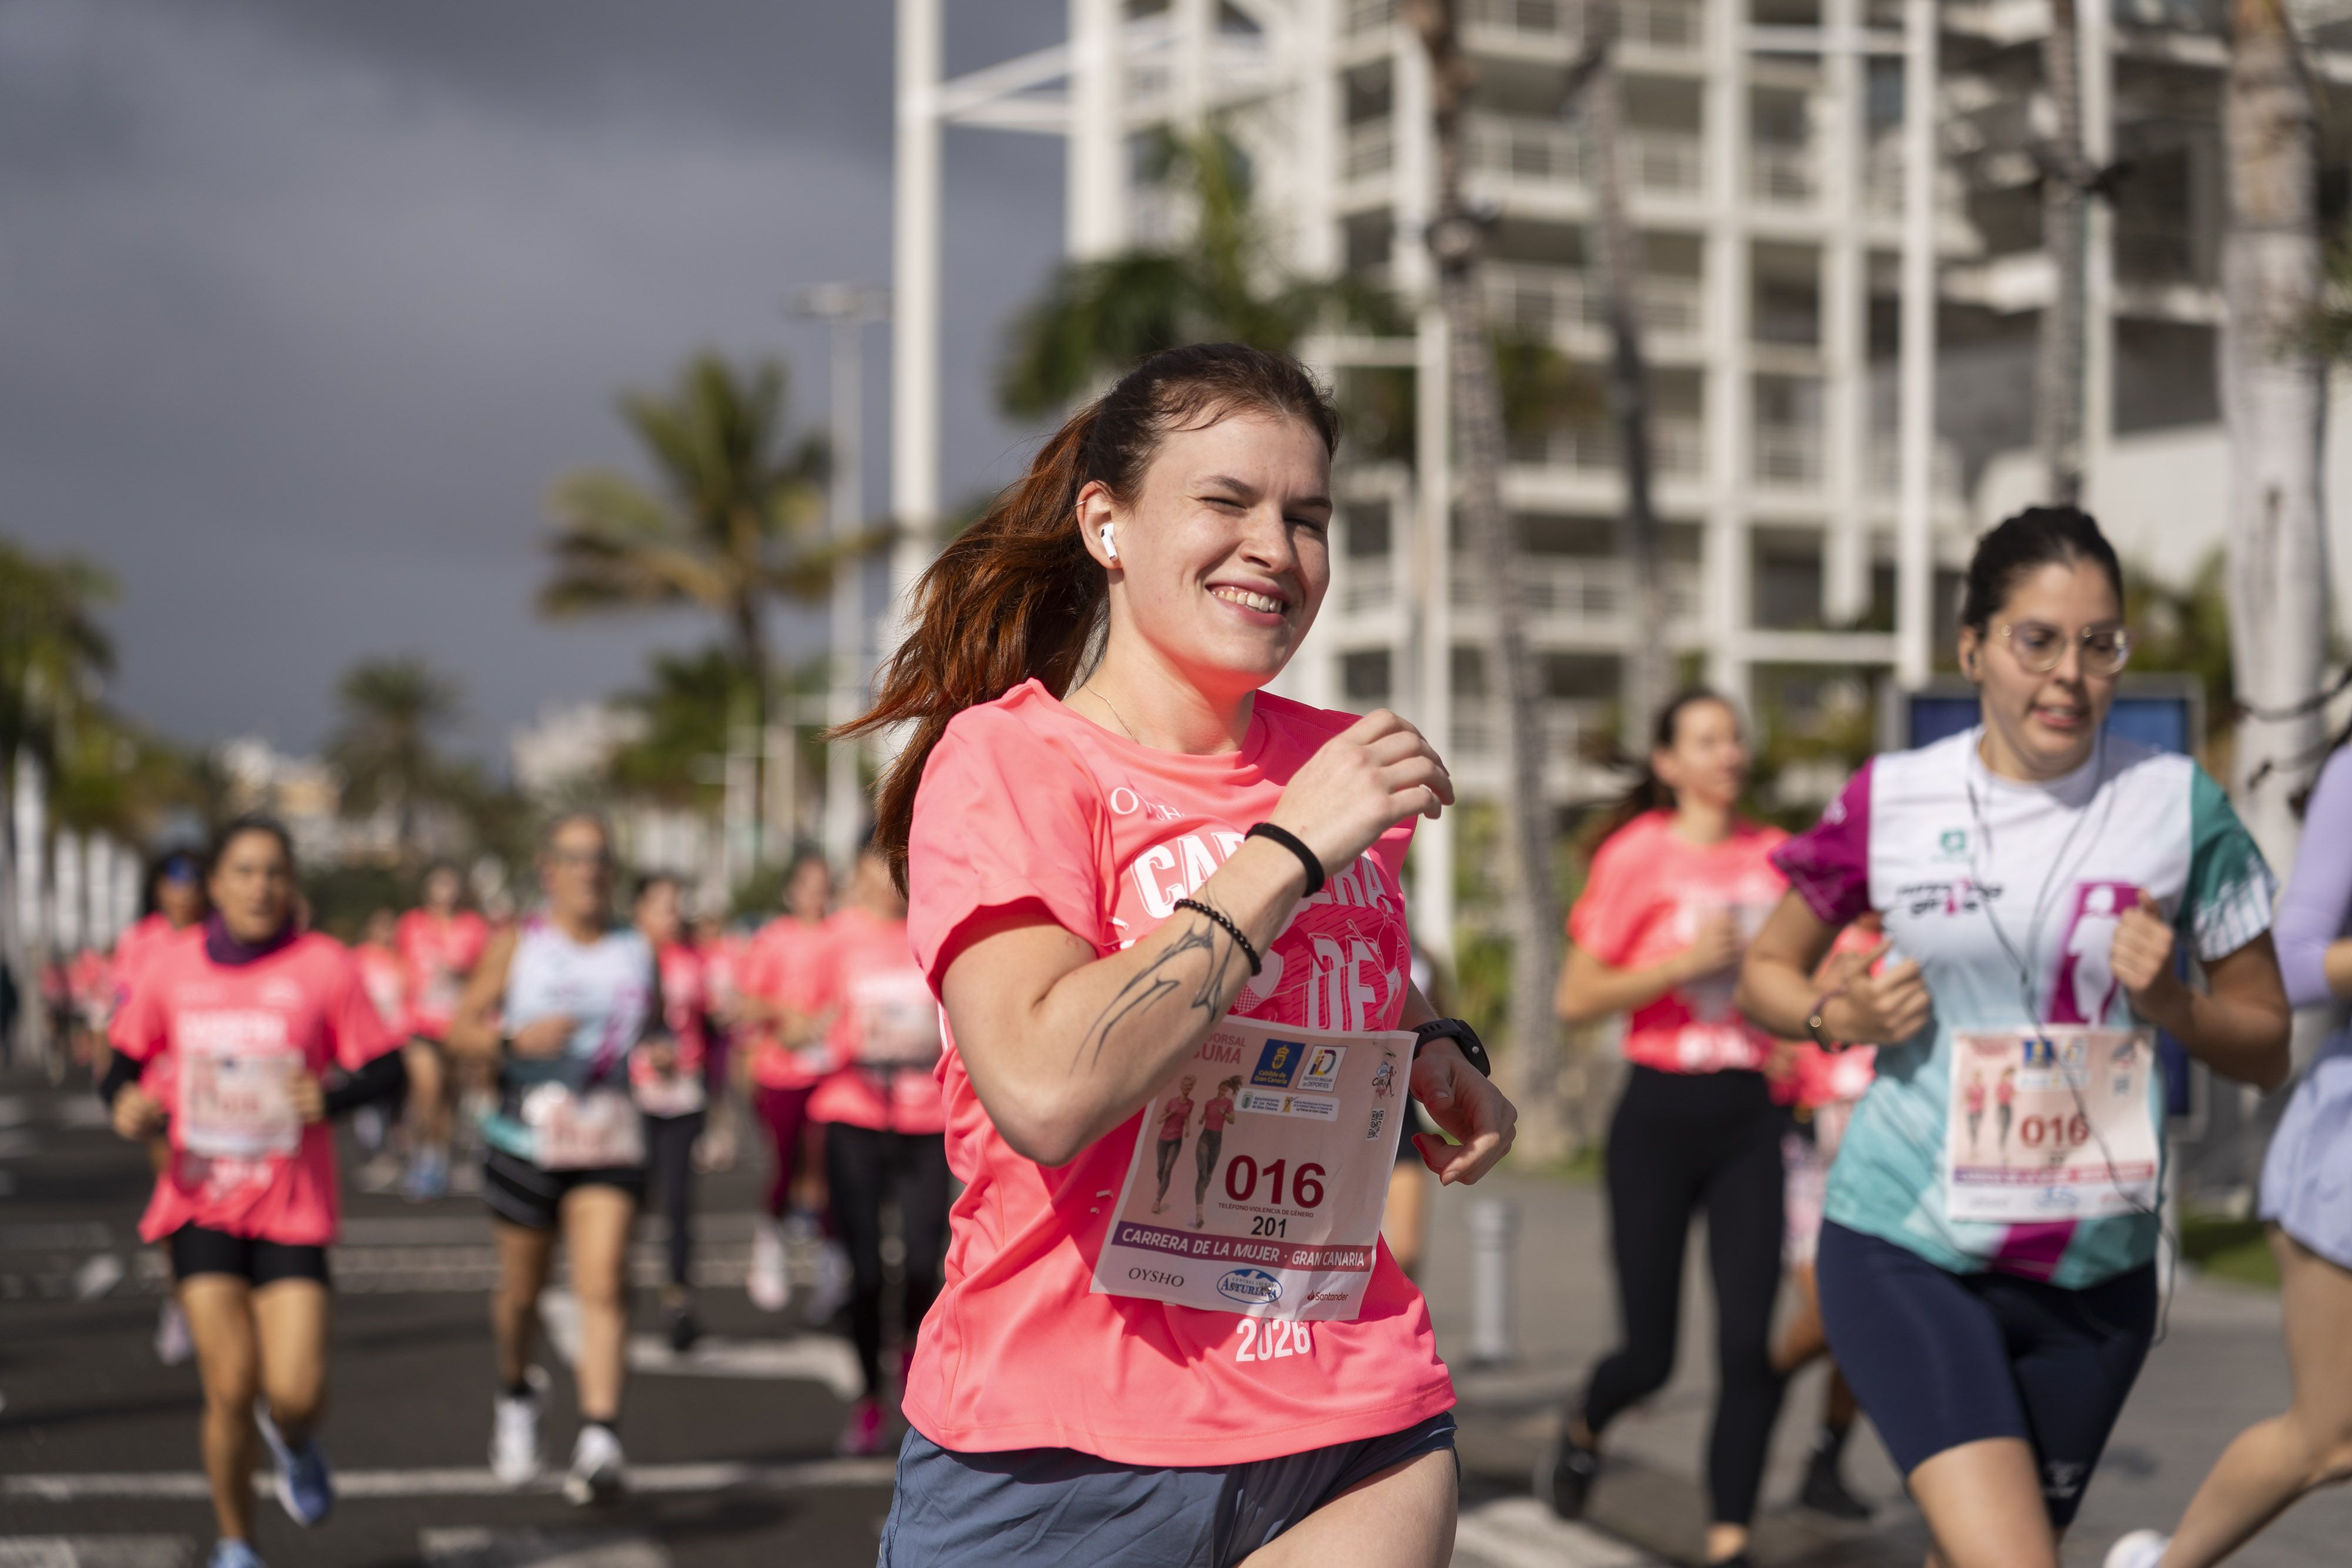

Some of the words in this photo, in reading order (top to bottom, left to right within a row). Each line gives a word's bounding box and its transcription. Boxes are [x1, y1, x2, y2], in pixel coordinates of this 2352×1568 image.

[1193, 1042, 1241, 1064] UMA
[2020, 1114, 2090, 1148] 016
[1225, 1155, 1326, 1209] 016
[1218, 1202, 1248, 1211] TELÉFONO
[1250, 1206, 1281, 1215] VIOLENCIA
[1290, 1209, 1314, 1218] GÉNERO
[1251, 1215, 1287, 1238] 201
[1122, 1228, 1188, 1252] CARRERA
[1192, 1239, 1211, 1255] DE
[1213, 1241, 1230, 1256] LA
[1233, 1243, 1280, 1262] MUJER
[1292, 1250, 1322, 1266] GRAN
[1322, 1252, 1364, 1266] CANARIA
[1128, 1267, 1184, 1287] OYSHO
[1315, 1292, 1349, 1302] Santander
[1235, 1318, 1311, 1362] 2026
